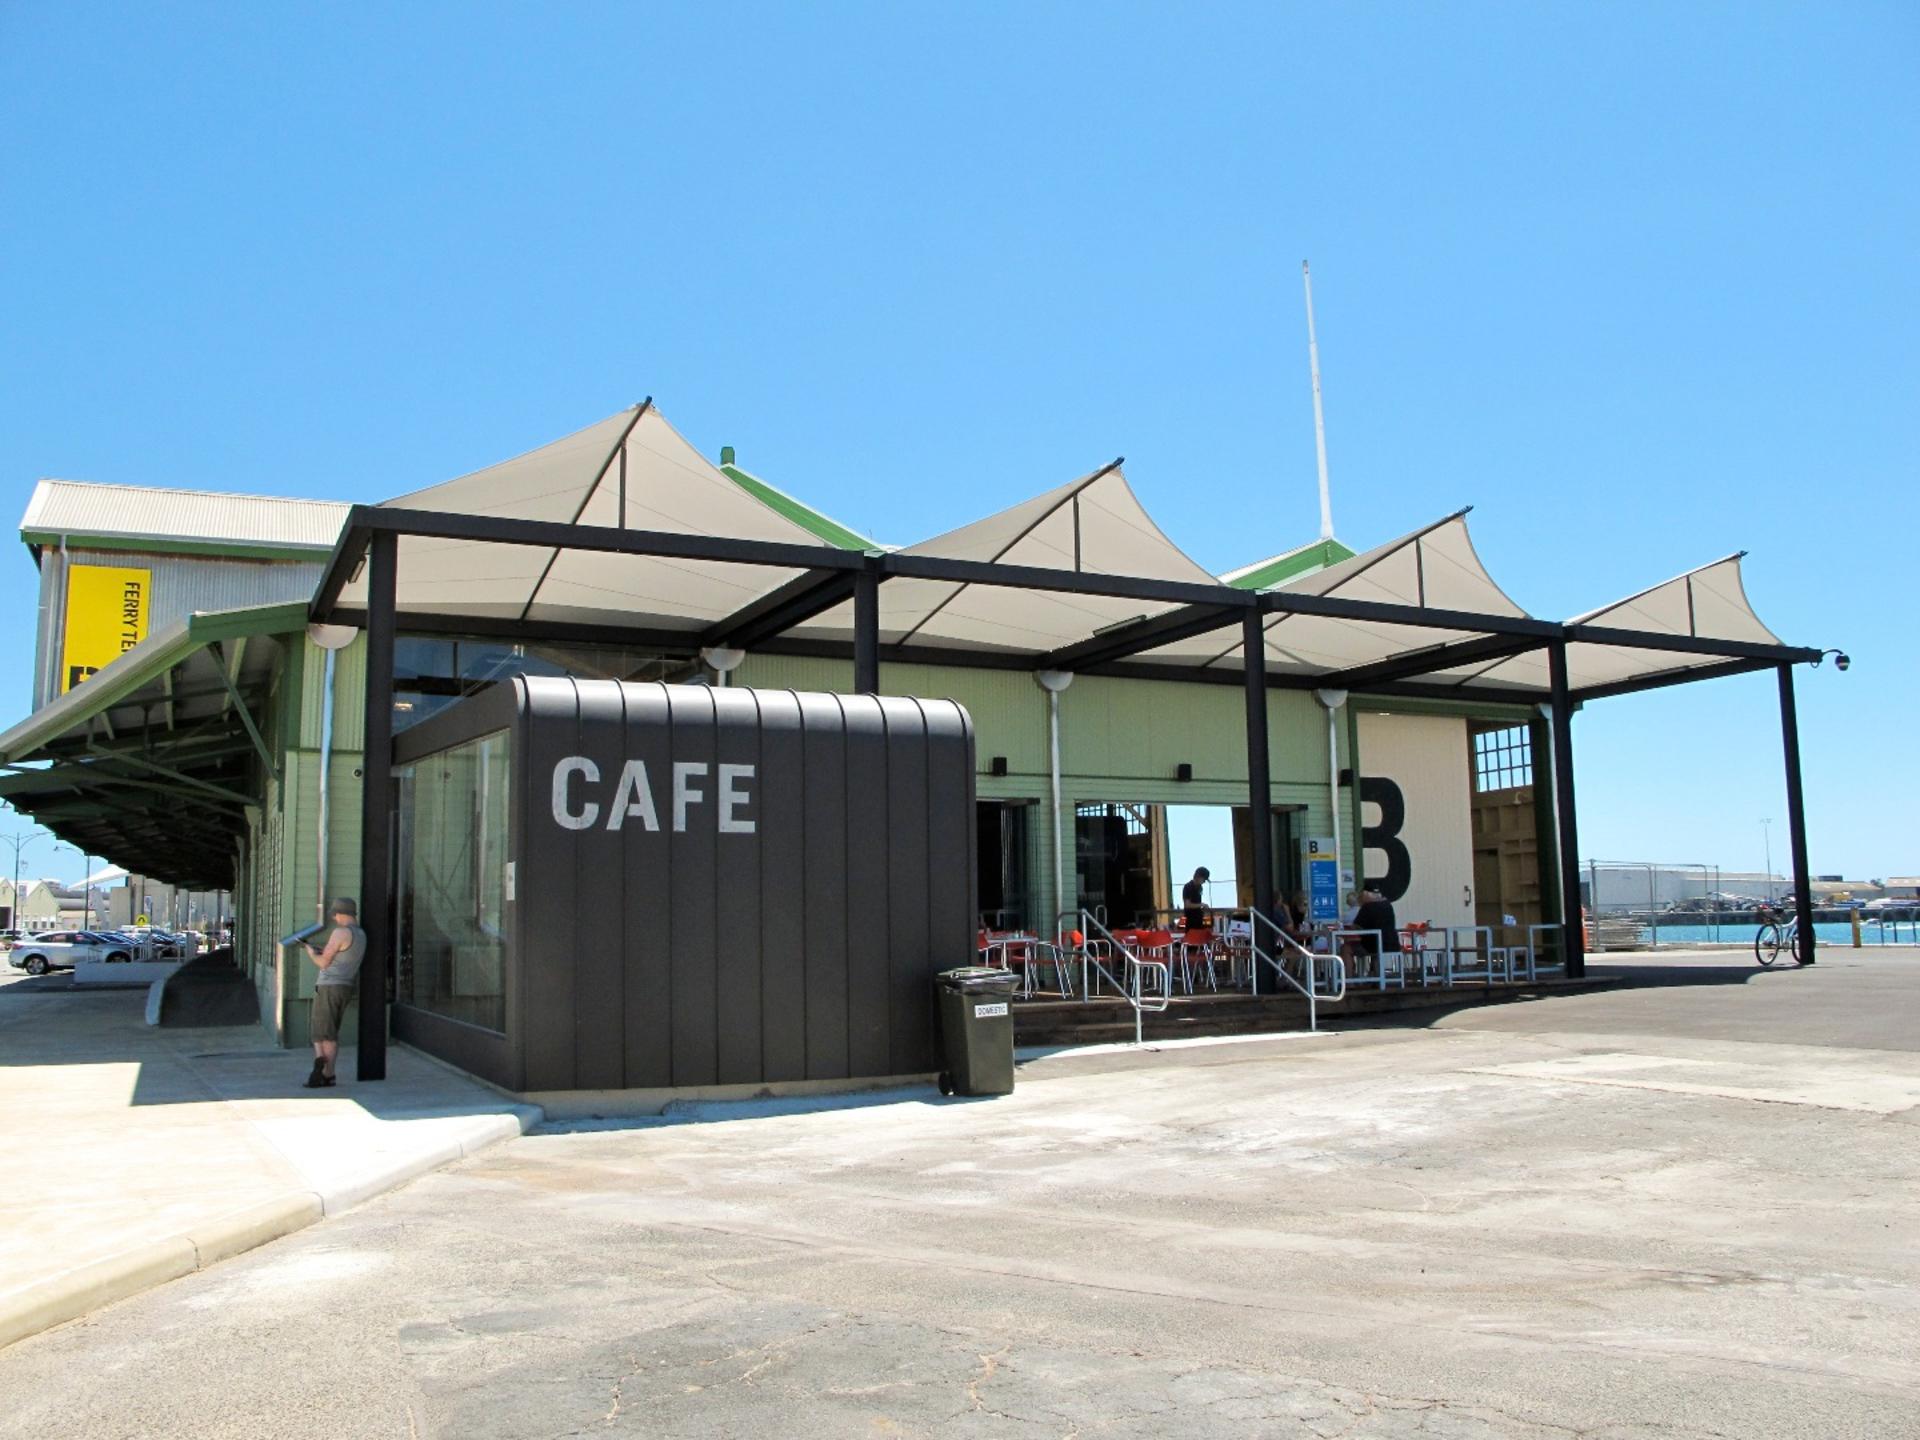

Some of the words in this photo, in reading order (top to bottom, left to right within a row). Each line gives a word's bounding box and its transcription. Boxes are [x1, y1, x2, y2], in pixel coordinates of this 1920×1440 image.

[123, 582, 140, 628] FERRY
[121, 631, 138, 653] TE
[552, 756, 756, 833] CAFE
[1309, 841, 1318, 853] B
[1360, 777, 1411, 902] B
